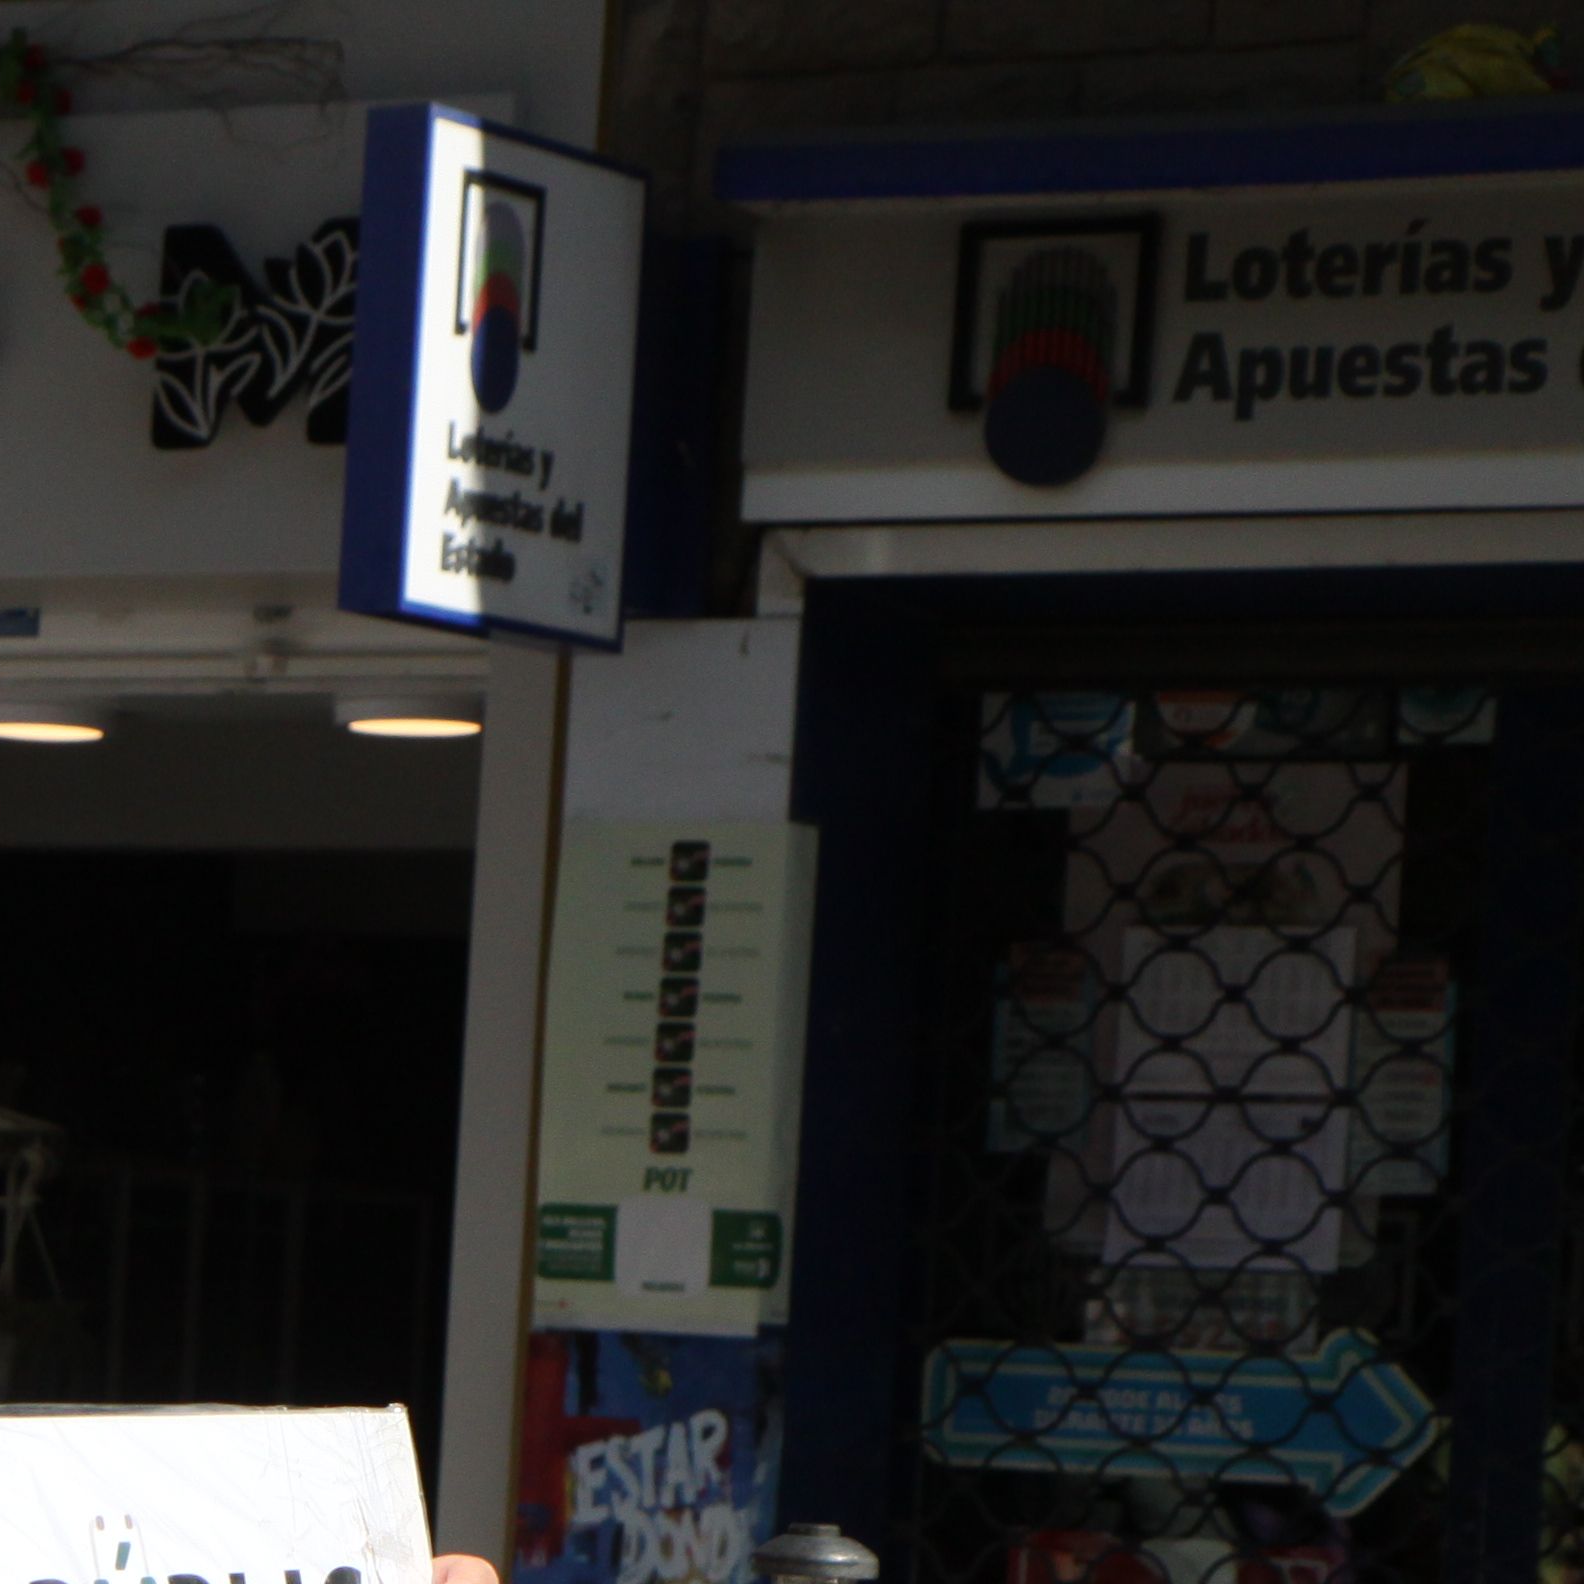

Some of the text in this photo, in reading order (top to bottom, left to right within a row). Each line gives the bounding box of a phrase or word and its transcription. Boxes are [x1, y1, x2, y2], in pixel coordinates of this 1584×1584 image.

[1182, 218, 1584, 311] Loterías y
[1172, 324, 1549, 421] Apuestas
[569, 1408, 730, 1531] ESTAR
